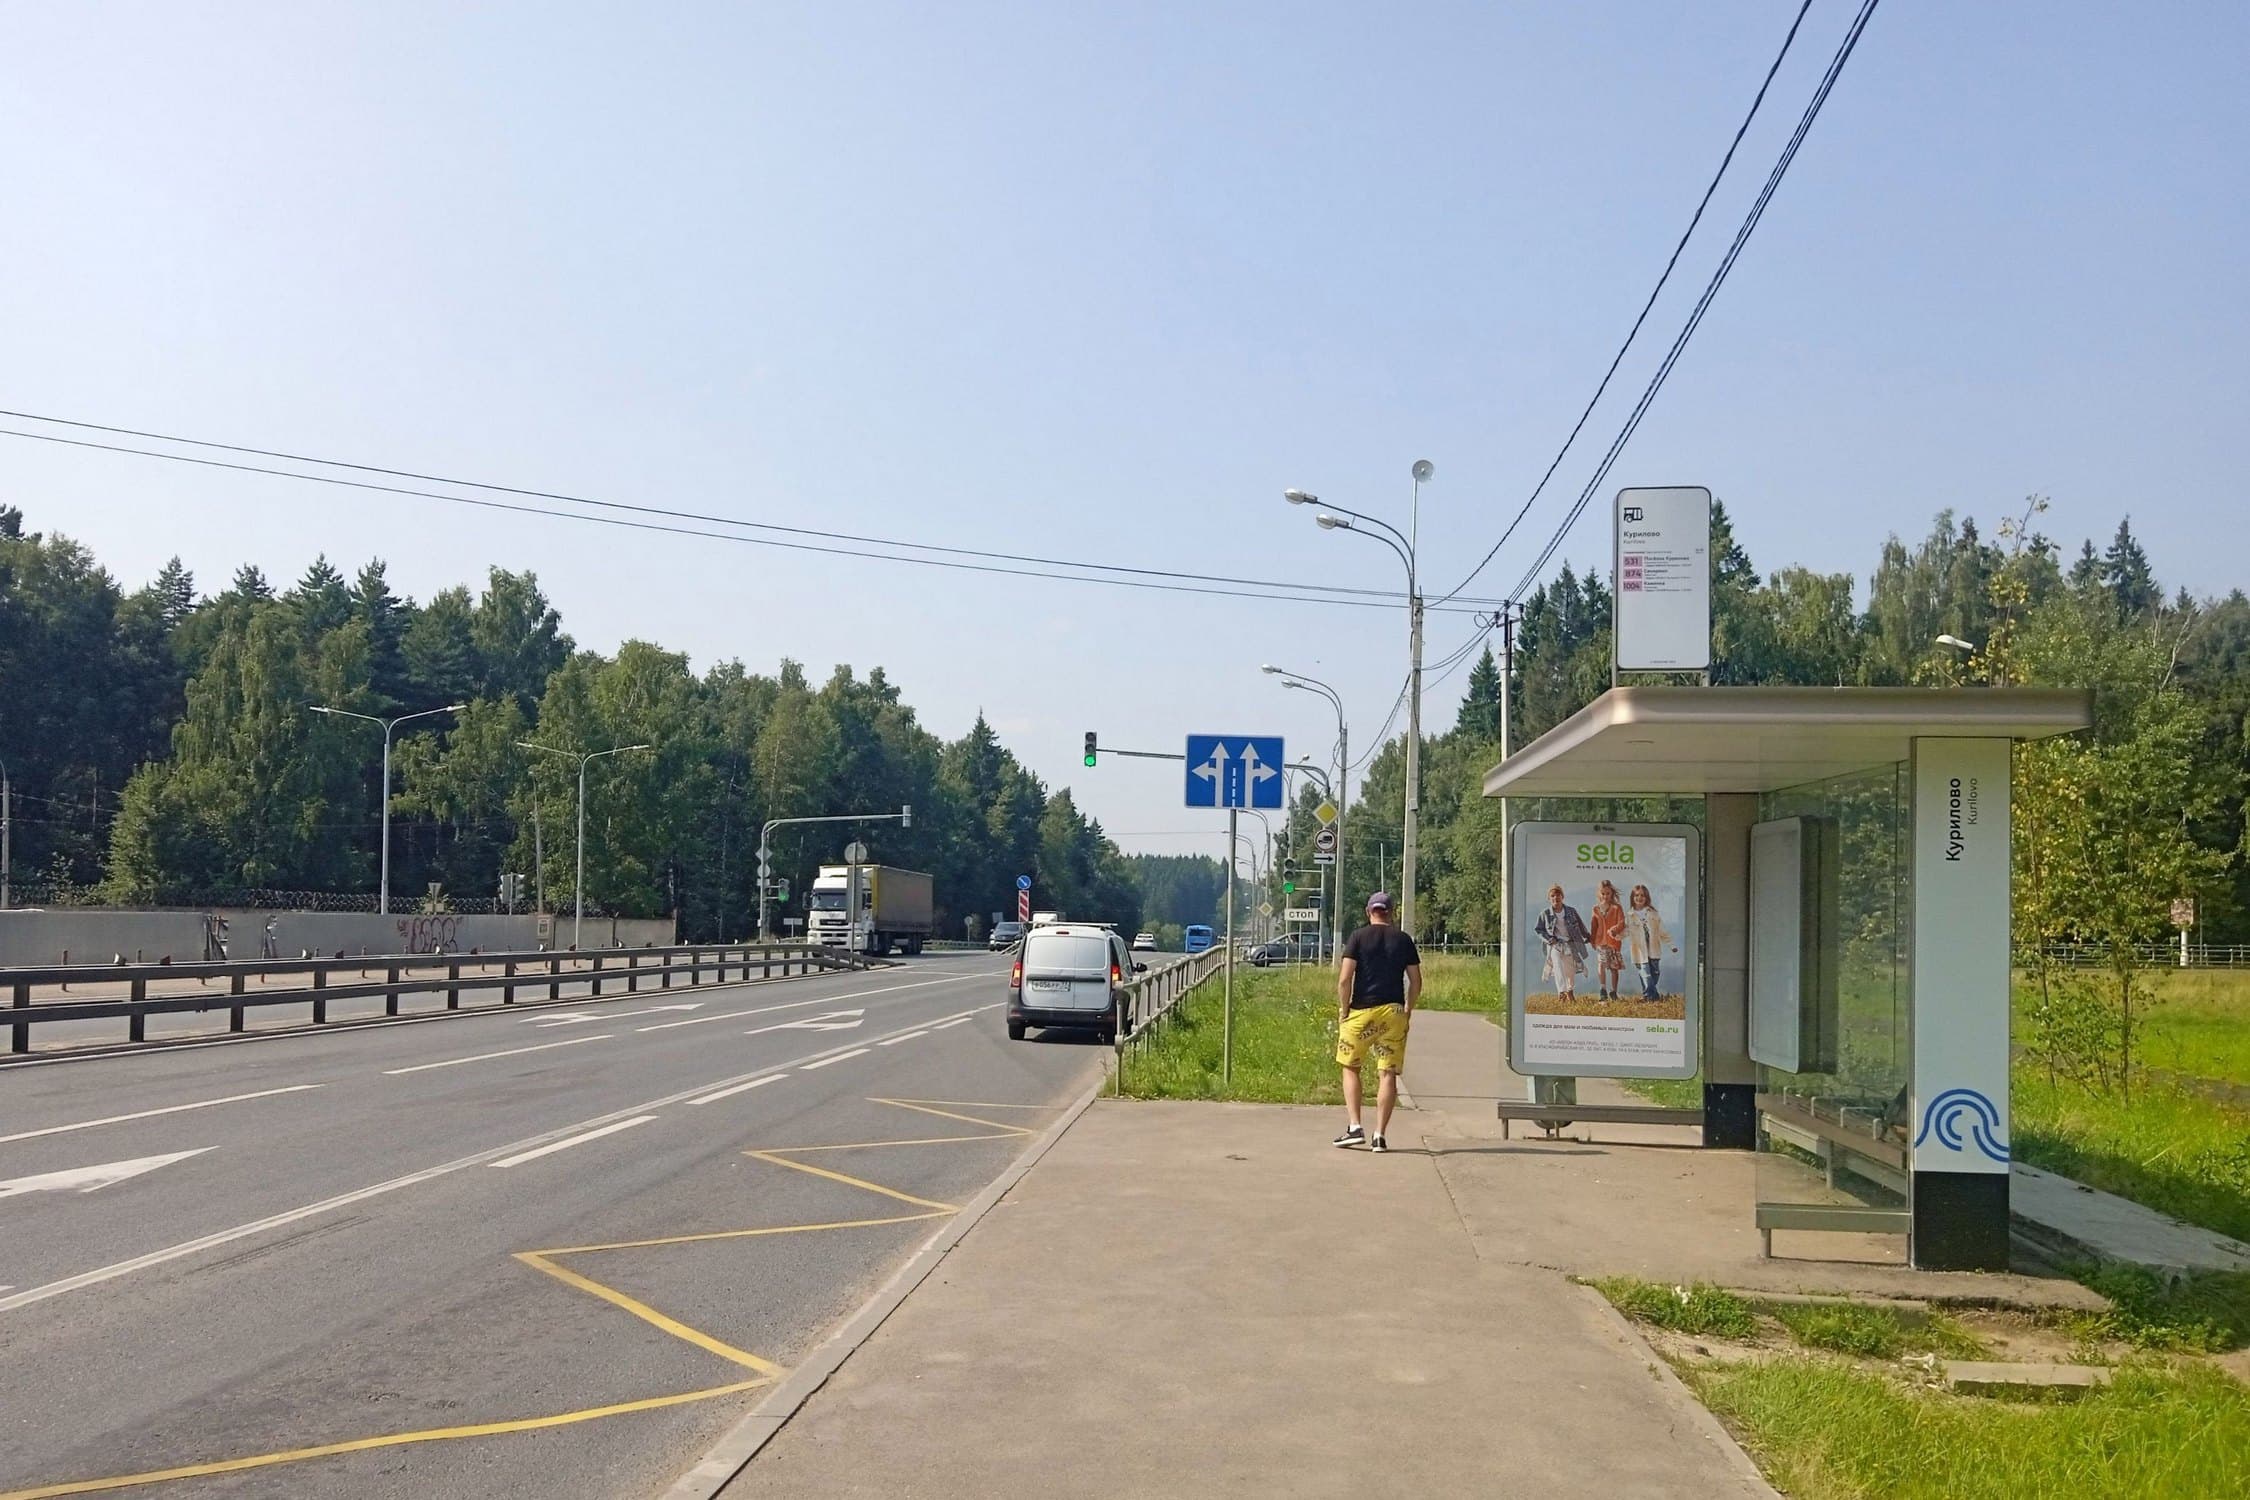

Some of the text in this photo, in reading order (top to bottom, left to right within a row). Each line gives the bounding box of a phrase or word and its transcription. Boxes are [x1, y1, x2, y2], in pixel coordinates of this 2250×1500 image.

[1624, 556, 1639, 566] 531
[1625, 568, 1642, 578] 874
[1623, 582, 1641, 591] 1004
[1967, 778, 1978, 825] Kurilovo
[1946, 778, 1965, 861] Курилово
[1577, 840, 1634, 864] sela
[1289, 911, 1314, 919] СТОП
[1646, 1024, 1679, 1034] sela.ru
